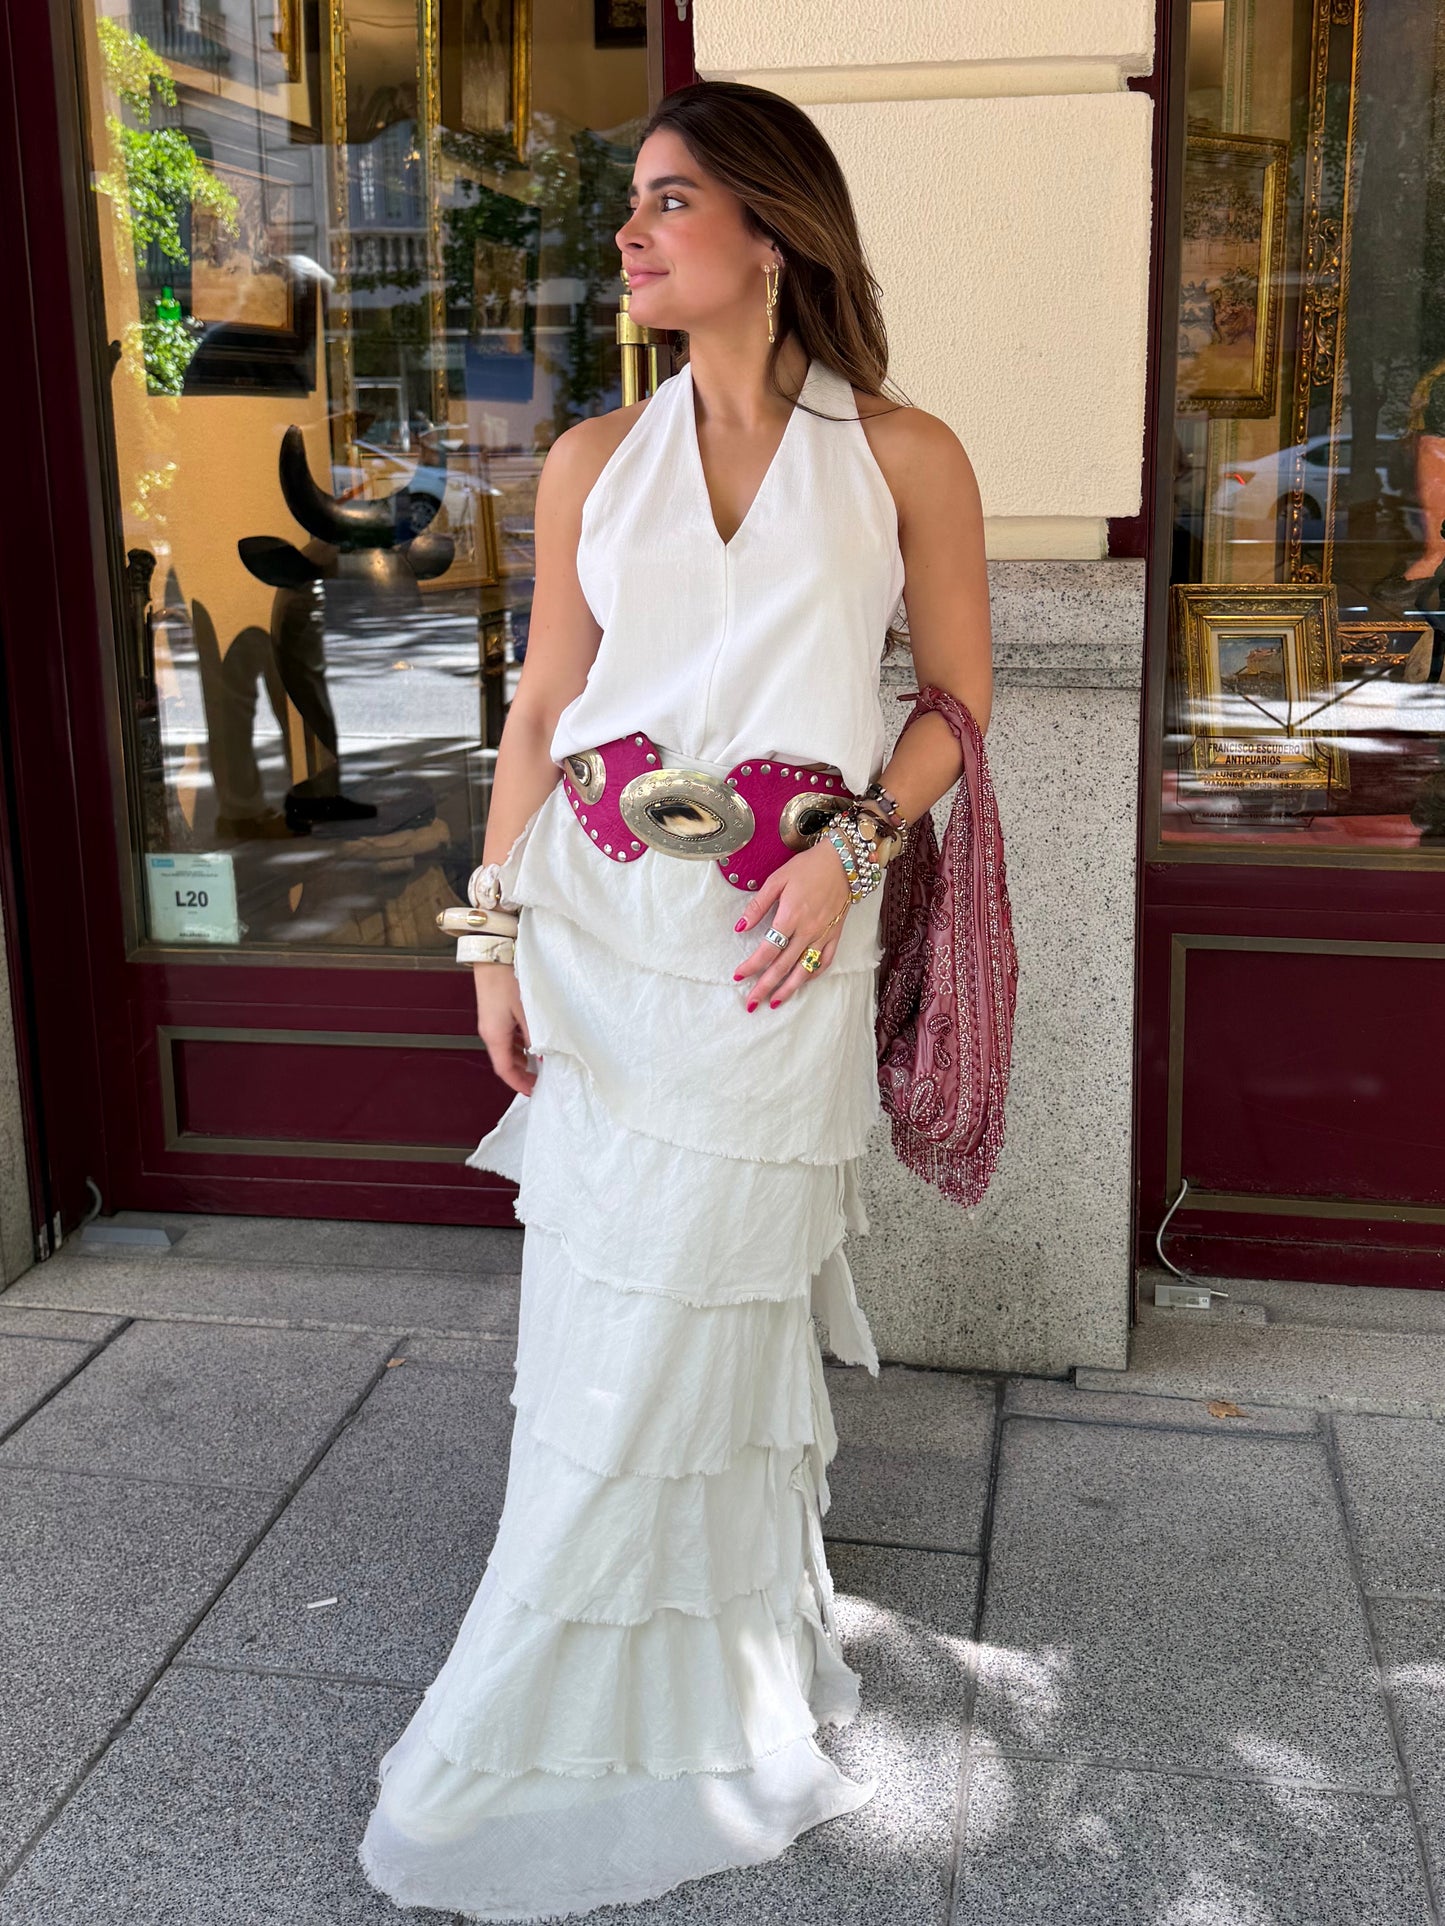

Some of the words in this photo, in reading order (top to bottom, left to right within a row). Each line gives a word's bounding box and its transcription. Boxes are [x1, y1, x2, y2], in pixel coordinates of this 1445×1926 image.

[1208, 743, 1254, 753] FRANCISCO
[1256, 744, 1301, 754] ESCUDERO
[1225, 755, 1281, 765] ANTICUARIOS
[1215, 771, 1242, 779] LUNES
[175, 890, 209, 907] L20
